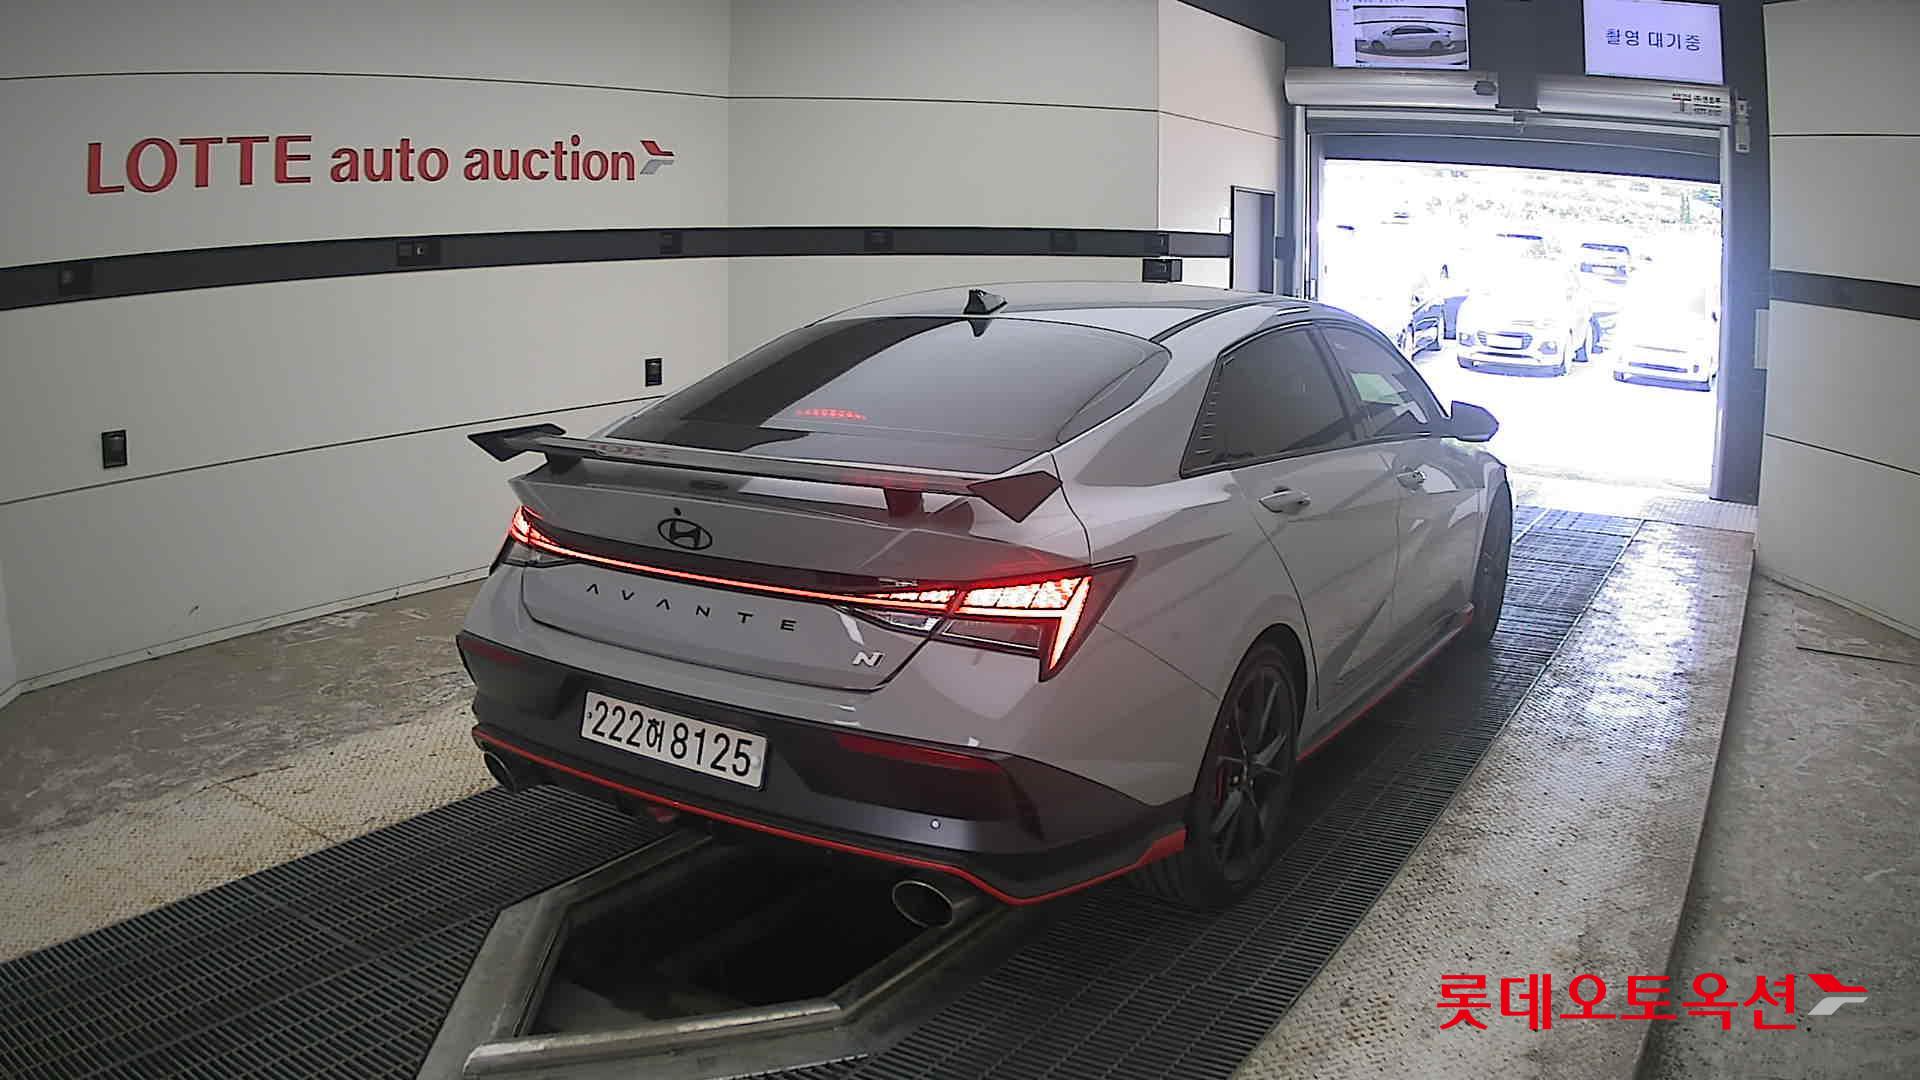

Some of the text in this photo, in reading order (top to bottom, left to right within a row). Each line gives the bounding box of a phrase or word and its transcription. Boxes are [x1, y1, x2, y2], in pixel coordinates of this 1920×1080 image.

[1647, 31, 1701, 51] 대기중
[87, 133, 636, 194] LOTTE auto auction
[585, 583, 798, 632] AVANTE
